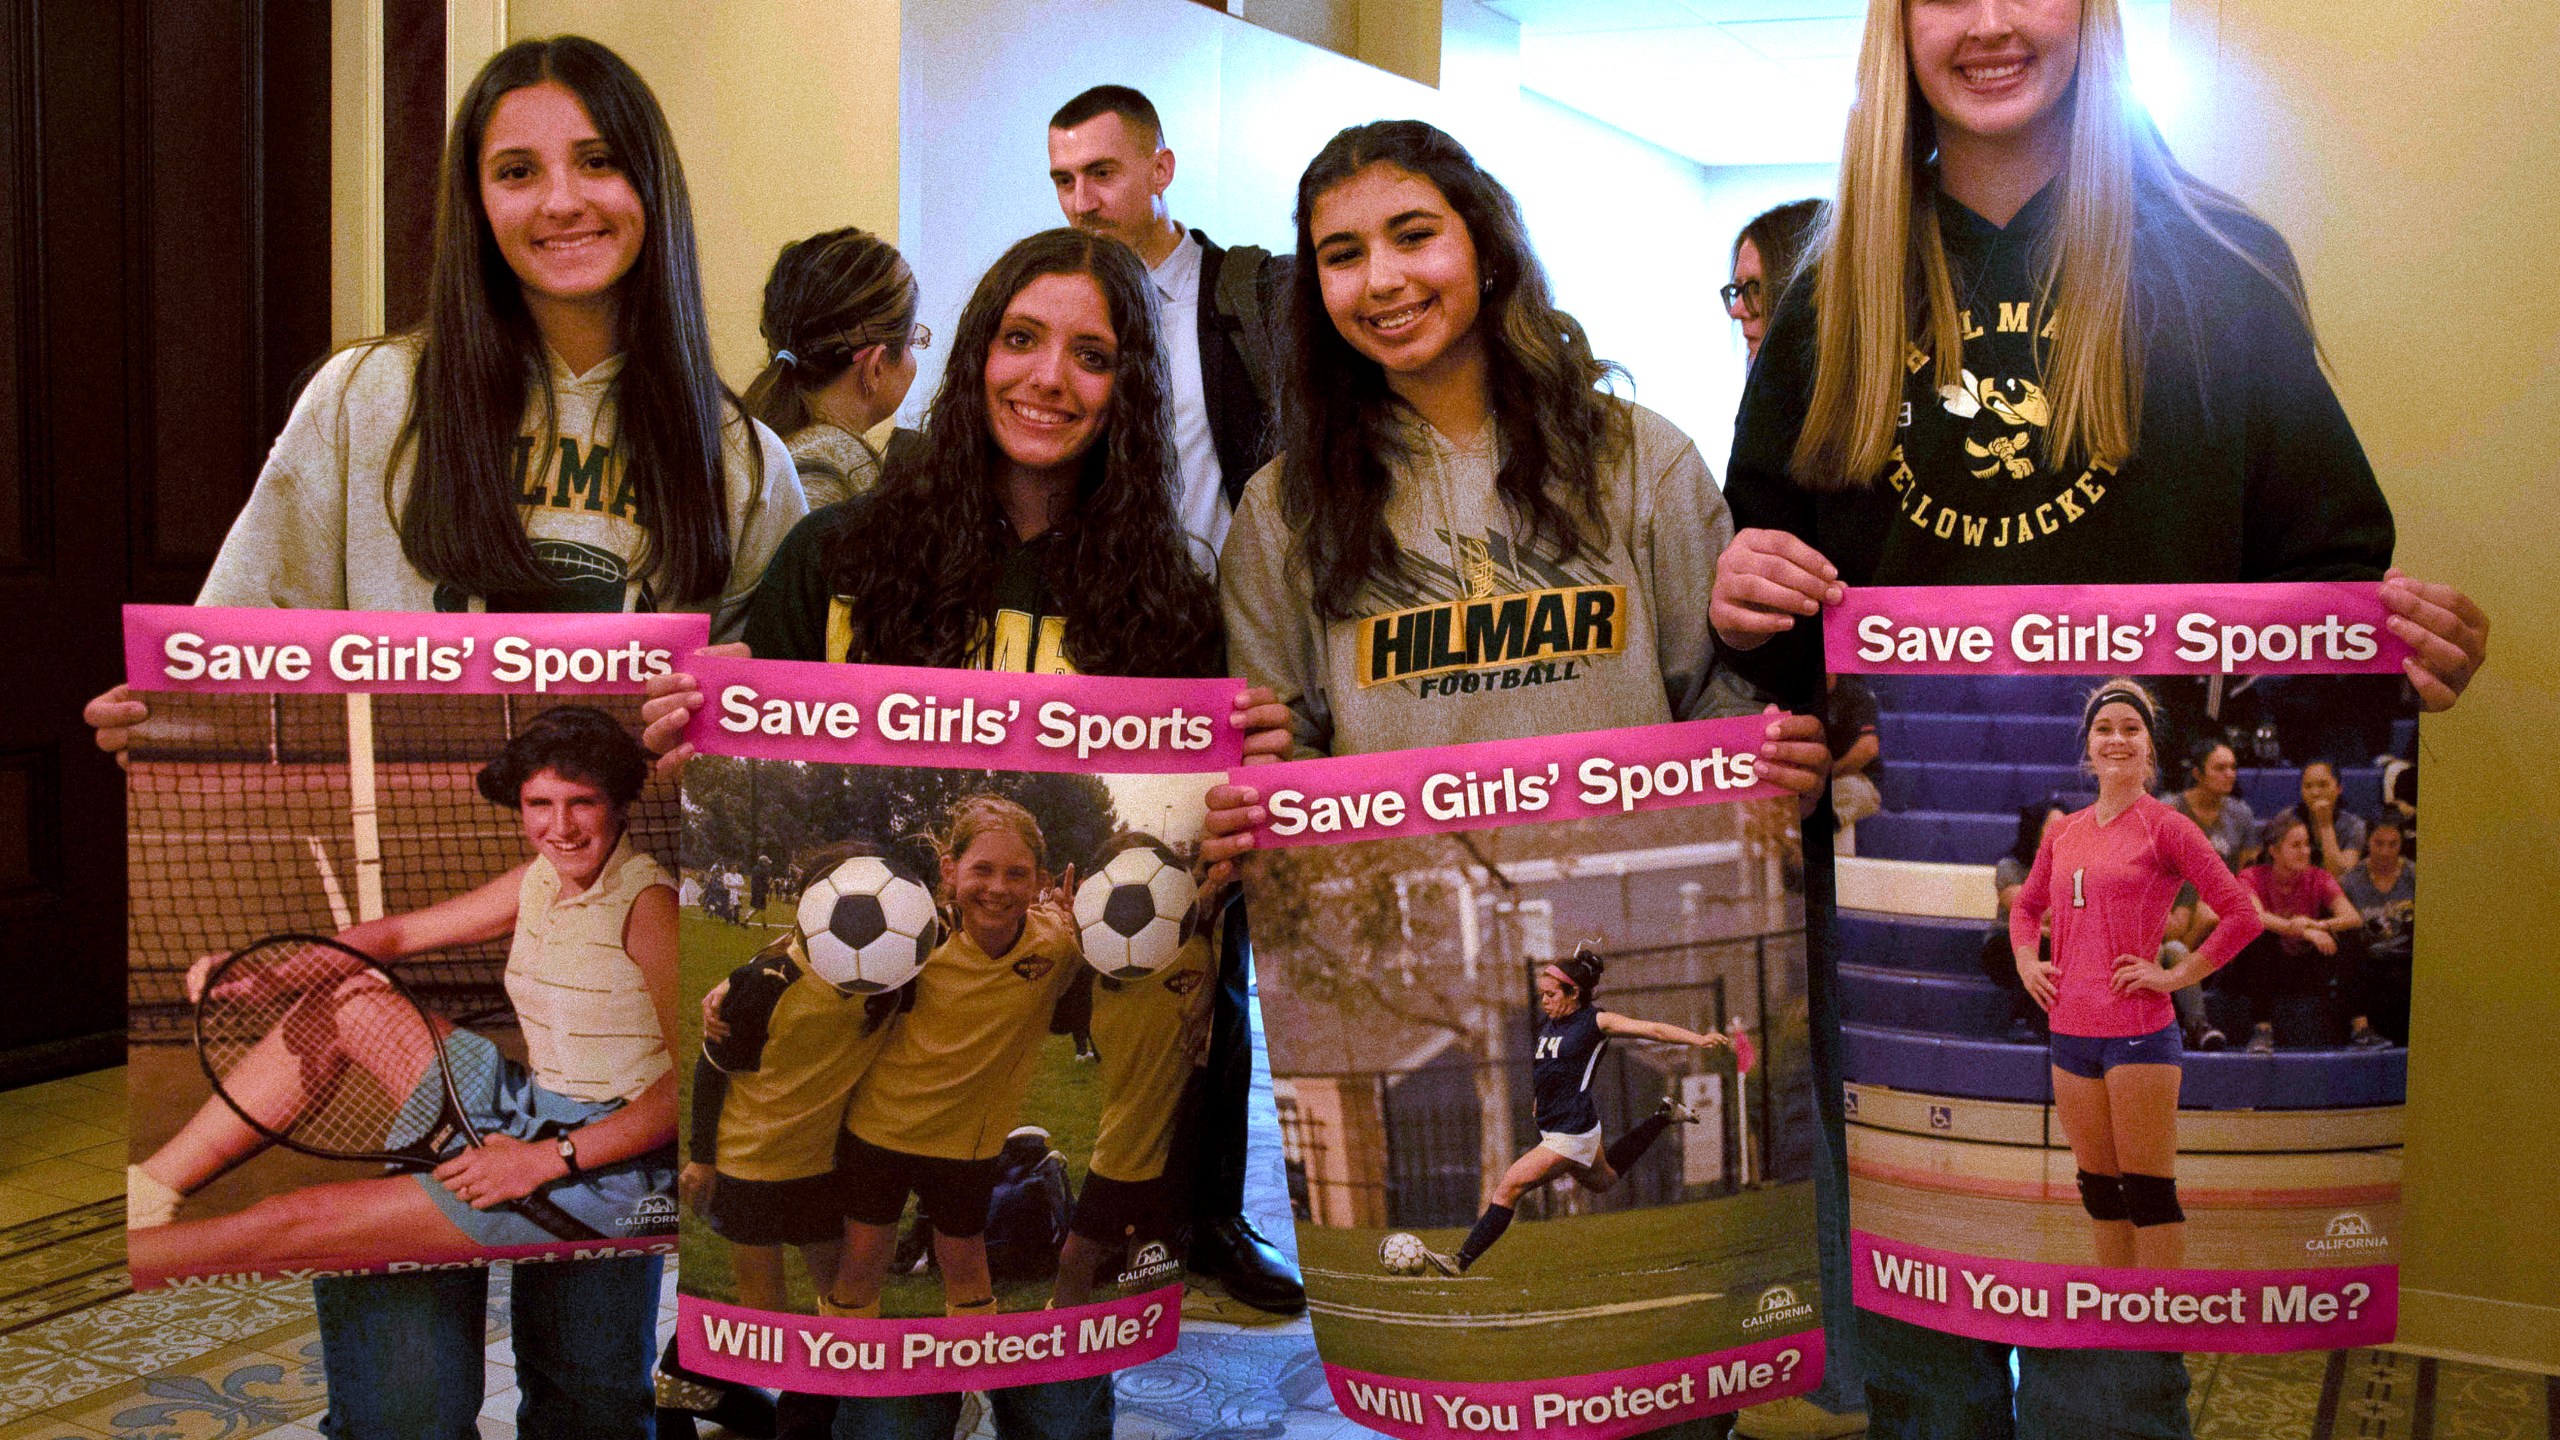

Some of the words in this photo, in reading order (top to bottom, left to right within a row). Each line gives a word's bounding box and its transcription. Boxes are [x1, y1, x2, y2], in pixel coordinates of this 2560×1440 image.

[163, 631, 312, 682] Save
[328, 633, 476, 682] Girls’
[492, 635, 673, 692] Sports
[1372, 590, 1615, 681] HILMAR
[1857, 613, 1994, 663] Save
[2010, 612, 2157, 663] Girls’
[2175, 612, 2377, 673] Sports
[1420, 661, 1580, 700] FOOTBALL
[719, 685, 860, 740] Save
[877, 692, 1021, 746] Girls’
[1035, 701, 1213, 760] Sports
[1268, 788, 1406, 836] Save
[1421, 762, 1560, 821] Girls’
[1578, 746, 1758, 812] Sports
[2072, 867, 2086, 908] 1
[615, 1214, 680, 1227] CALIFORN
[2305, 1236, 2388, 1251] CALIFORNIA
[1117, 1258, 1180, 1283] CALIFORNIA
[1872, 1249, 1947, 1303] Will
[1961, 1270, 2048, 1318] You
[2066, 1281, 2246, 1324] Protect
[2262, 1282, 2371, 1324] Me?
[702, 1314, 784, 1363] Will
[799, 1329, 886, 1371] You
[902, 1324, 1067, 1370] Protect
[1078, 1303, 1163, 1354] Me?
[1741, 1303, 1814, 1329] CALIFORNIA
[1346, 1379, 1424, 1426] Will
[1433, 1394, 1519, 1433] You
[1533, 1373, 1696, 1430] Protect
[1708, 1349, 1802, 1399] Me?
